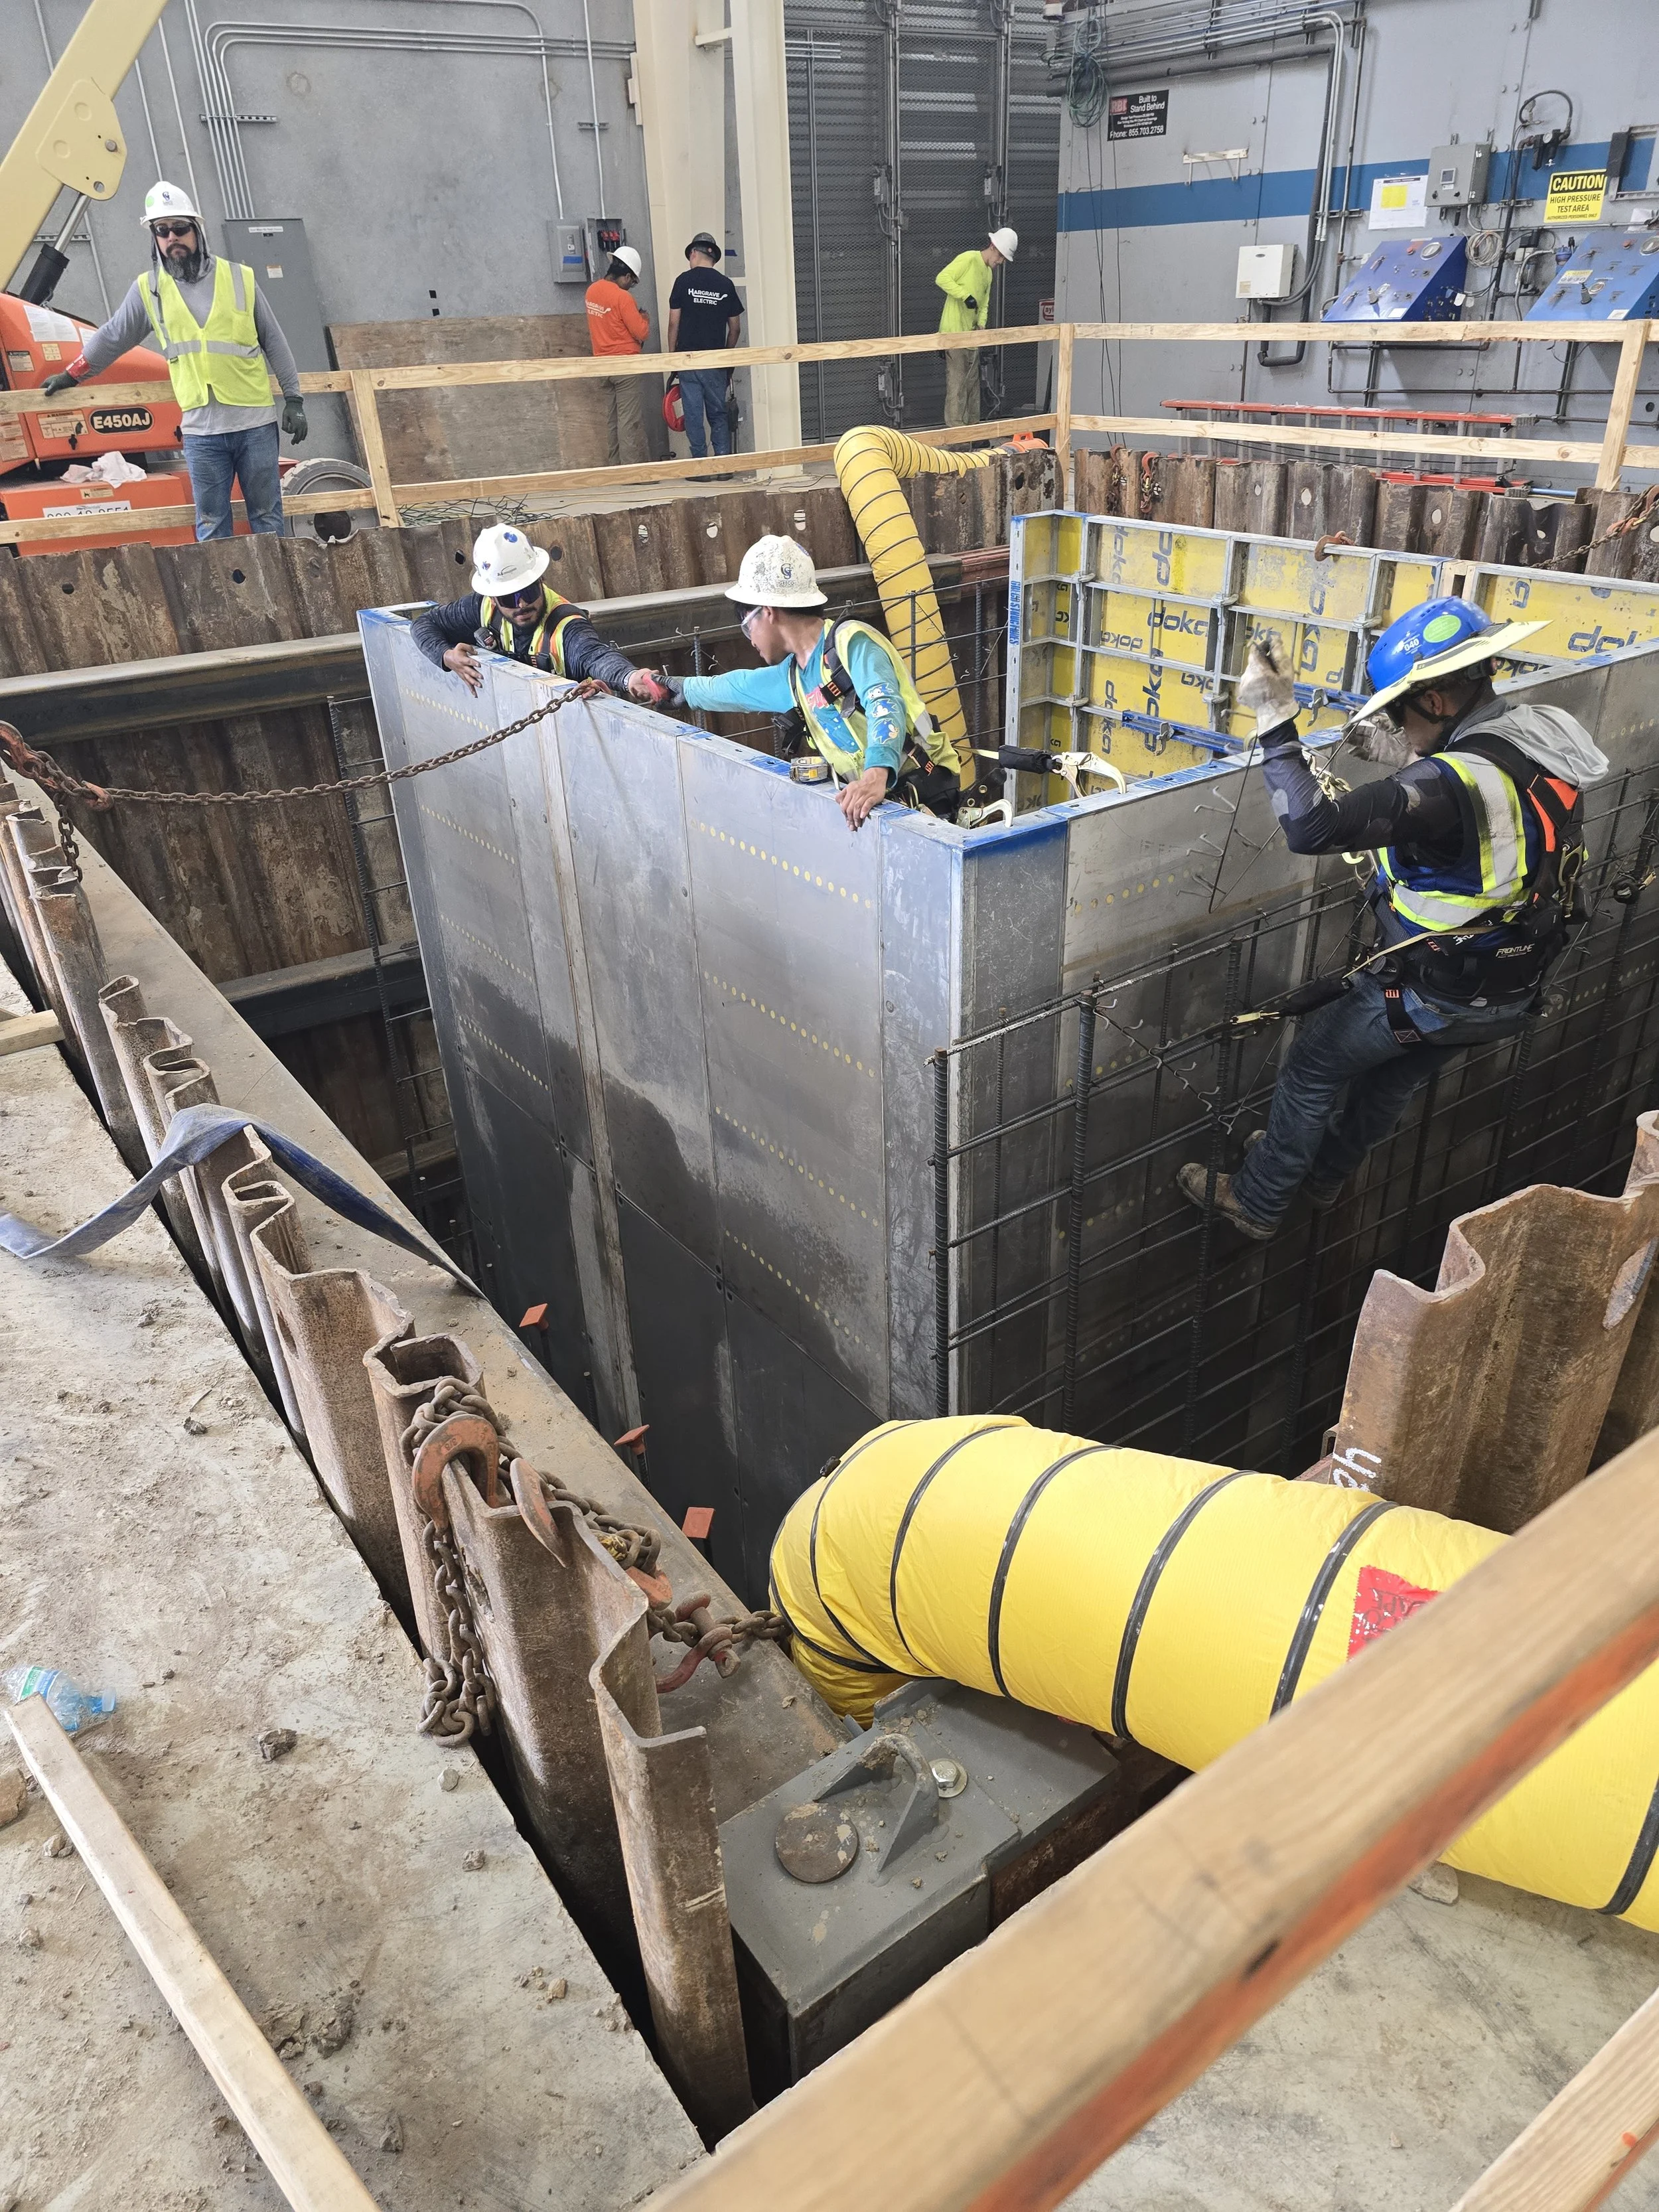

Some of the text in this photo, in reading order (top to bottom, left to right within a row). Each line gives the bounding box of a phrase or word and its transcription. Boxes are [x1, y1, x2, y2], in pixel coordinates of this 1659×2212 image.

[1139, 95, 1151, 104] Built
[1130, 101, 1165, 113] Stand Behind
[1128, 125, 1164, 137] 855.703.2758
[1553, 174, 1605, 192] CAUTION
[1567, 193, 1601, 203] PRESSURE
[1572, 204, 1589, 212] AREA
[688, 288, 720, 298] HARGRAVE
[93, 412, 151, 429] E450AJ
[1404, 638, 1420, 652] 040
[1495, 943, 1536, 957] FRONTLINE
